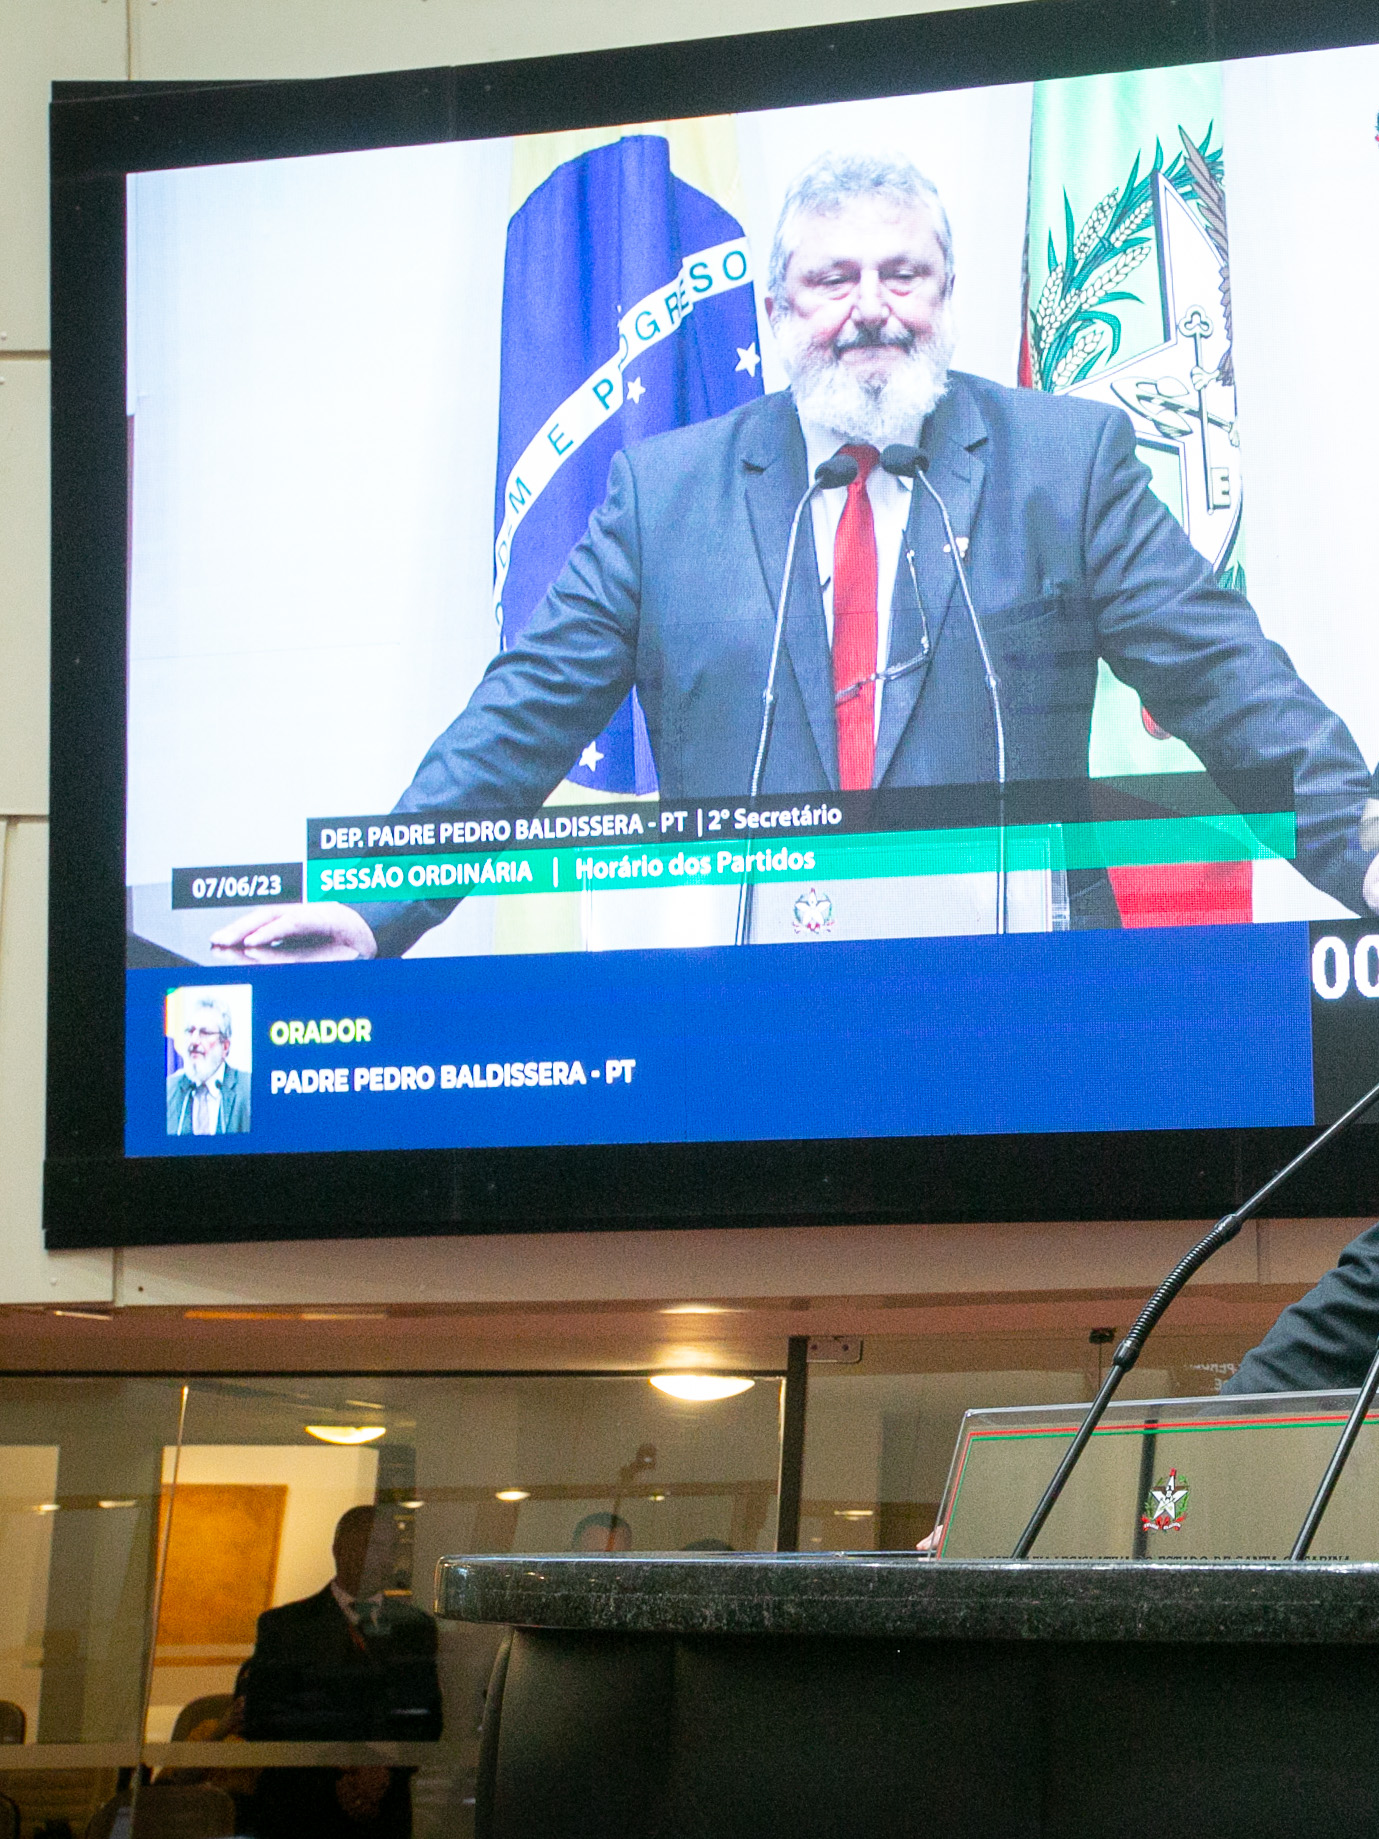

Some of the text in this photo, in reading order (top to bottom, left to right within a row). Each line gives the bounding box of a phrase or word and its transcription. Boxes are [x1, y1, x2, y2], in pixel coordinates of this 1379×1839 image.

[320, 827, 364, 849] DEP.
[367, 824, 435, 847] PADRE
[439, 820, 511, 843] PEDRO
[515, 814, 644, 840] BALDISSERA
[660, 811, 688, 833] PT
[734, 804, 842, 829] Secretário
[192, 874, 282, 898] 07/06/23
[320, 864, 404, 891] SESSÃO
[408, 857, 533, 887] ORDINÁRIA
[576, 854, 664, 879] Horário
[668, 852, 711, 876] dos
[716, 847, 816, 873] Partidos
[270, 1018, 372, 1045] ORADOR
[271, 1068, 349, 1094] PADRE
[354, 1065, 435, 1091] PEDRO
[440, 1061, 586, 1089] BALDISSERA
[606, 1059, 636, 1084] PT
